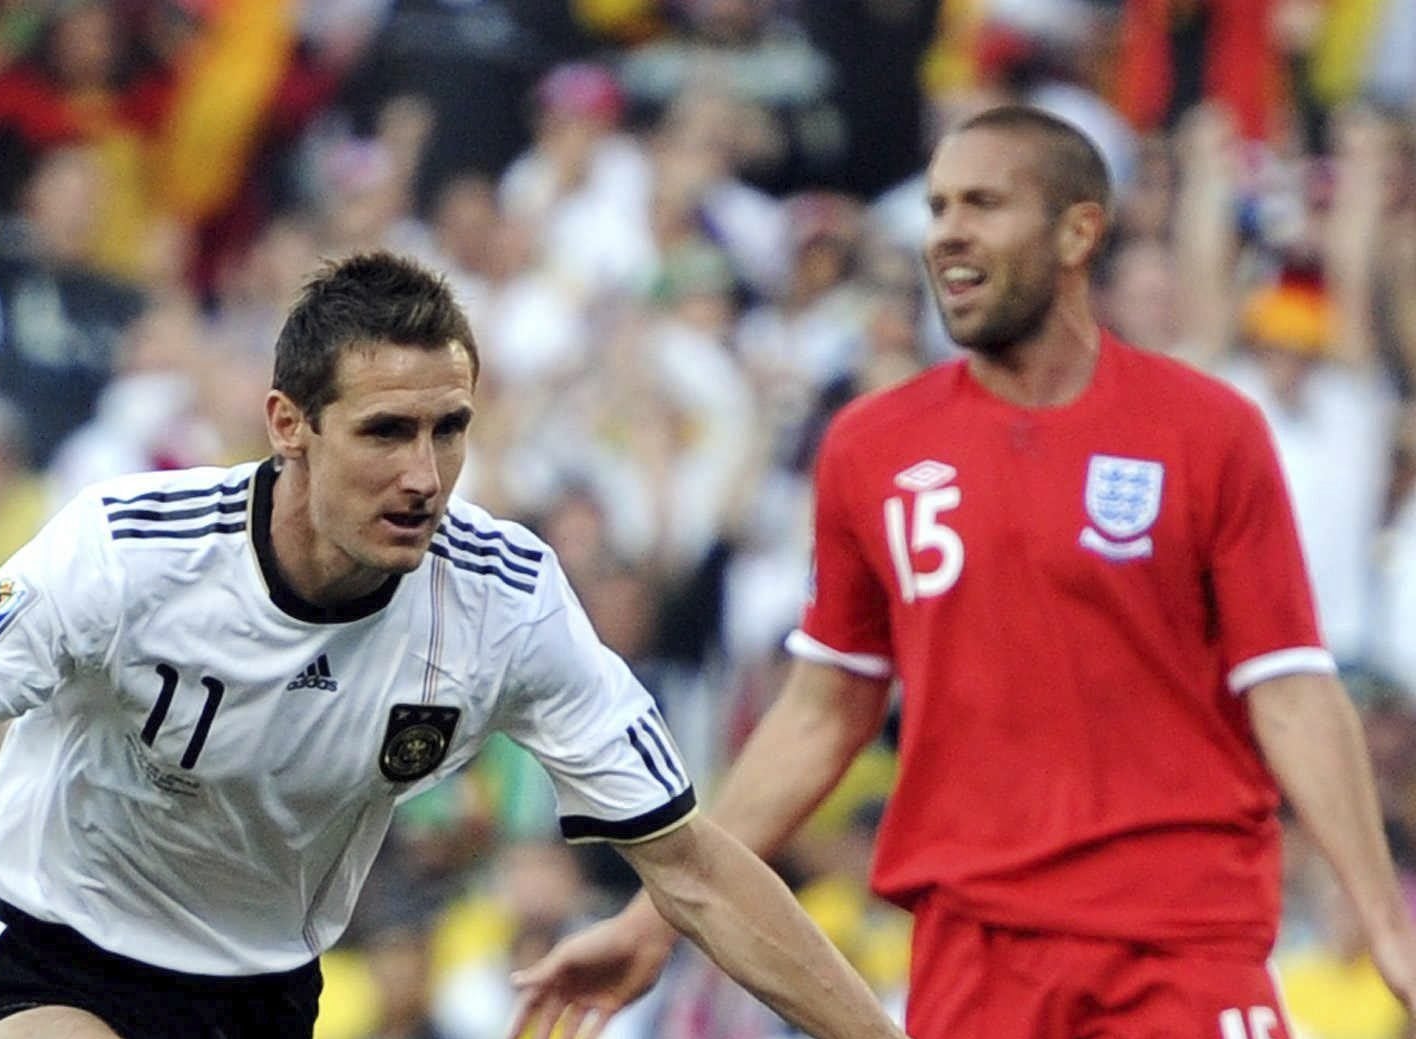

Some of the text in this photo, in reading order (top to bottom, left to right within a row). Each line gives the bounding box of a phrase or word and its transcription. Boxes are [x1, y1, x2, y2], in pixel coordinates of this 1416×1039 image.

[884, 485, 965, 604] 15
[141, 663, 225, 769] 11
[286, 674, 338, 692] adidas
